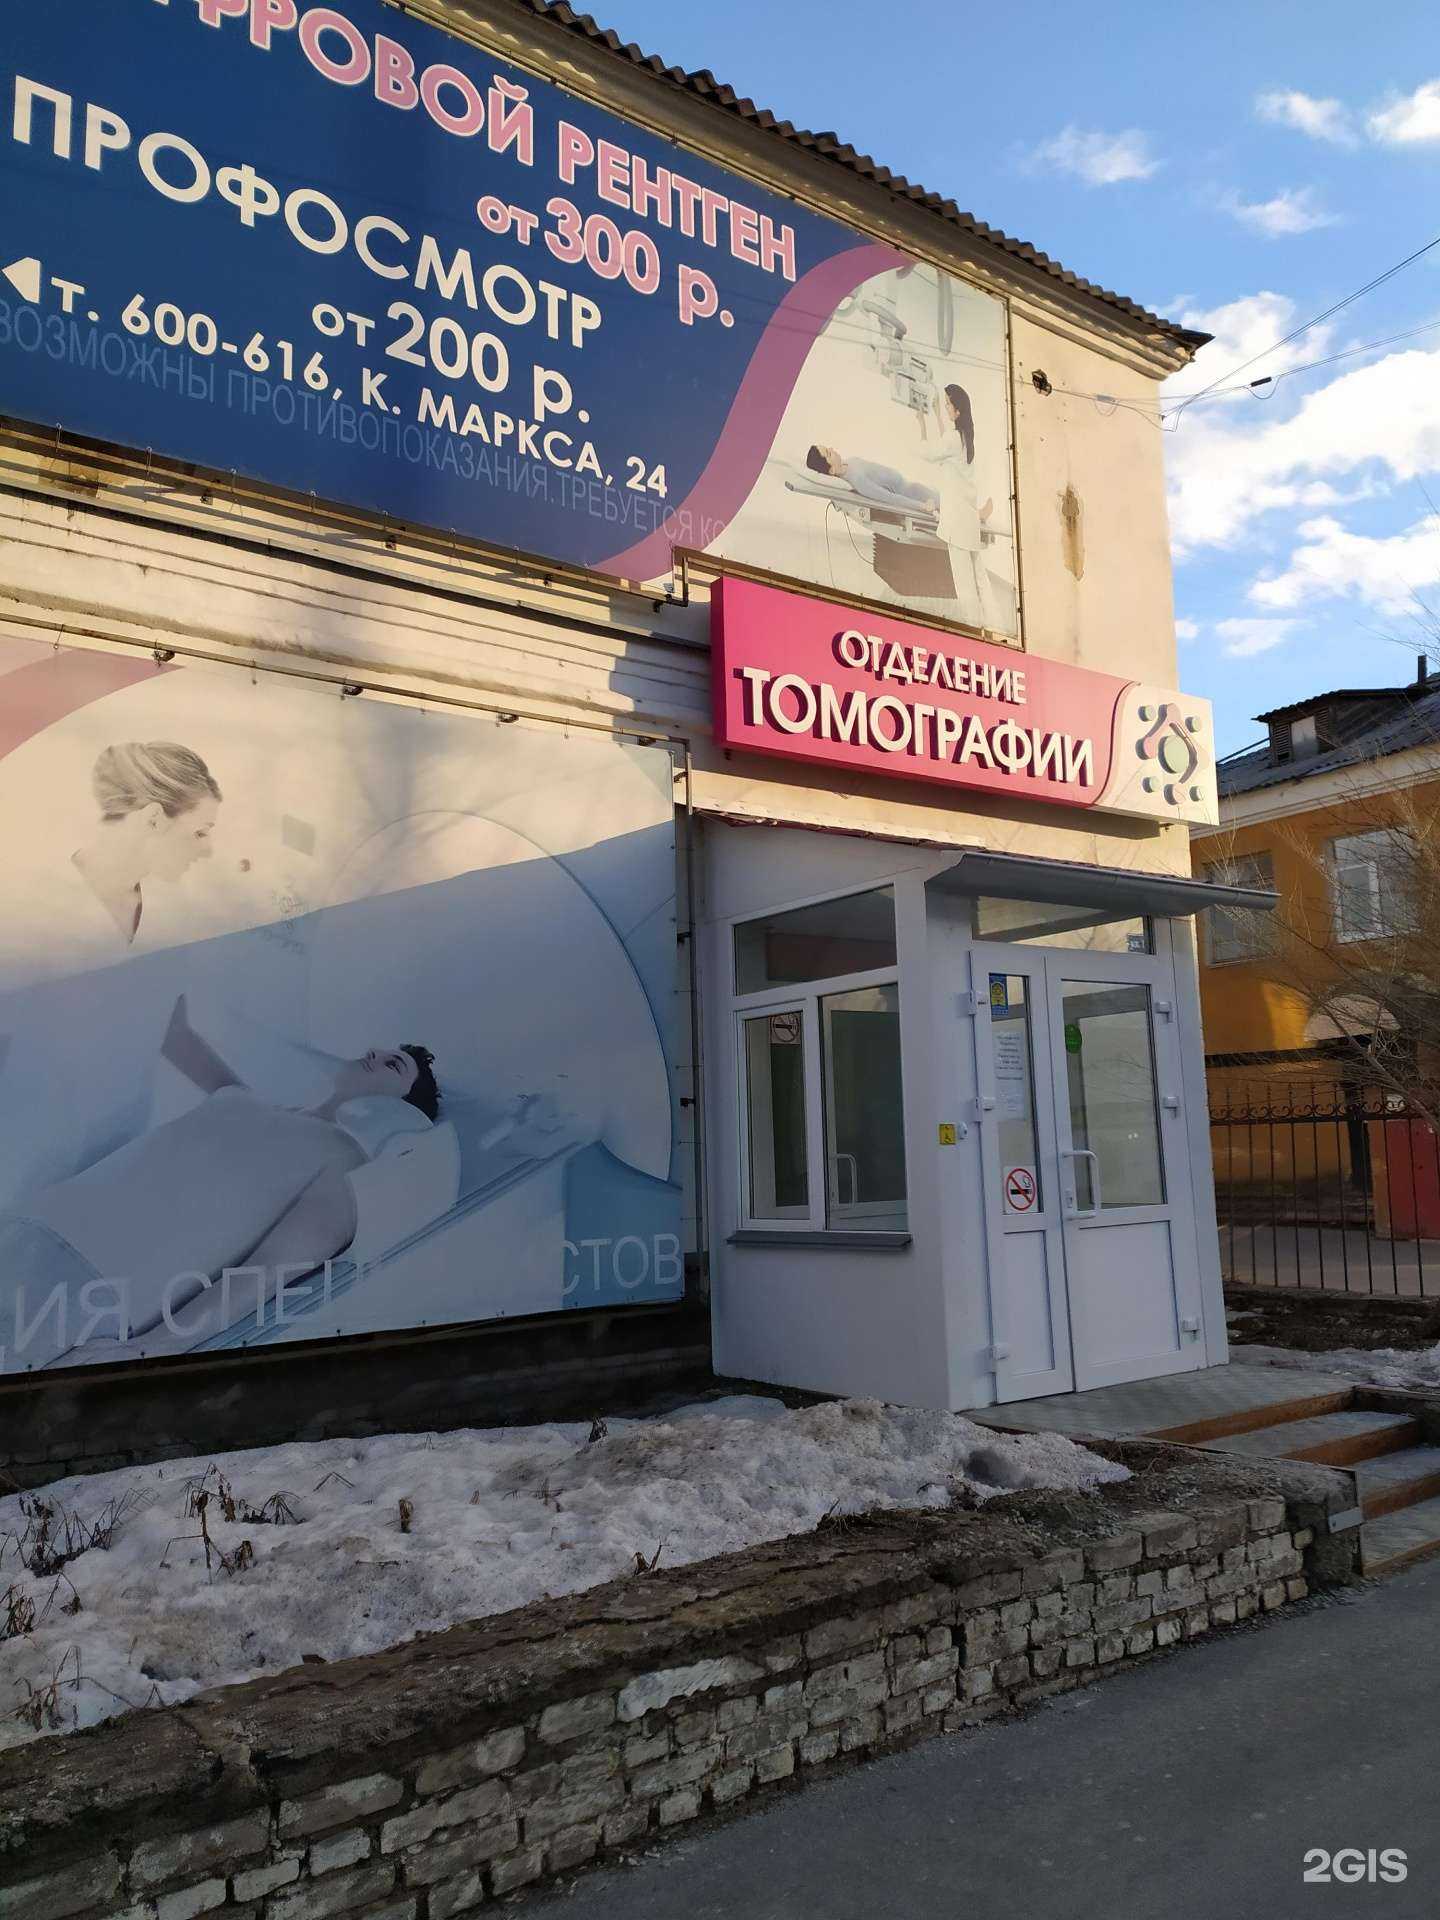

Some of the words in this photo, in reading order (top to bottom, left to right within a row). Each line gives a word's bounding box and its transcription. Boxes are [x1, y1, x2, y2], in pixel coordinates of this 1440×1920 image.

[156, 0, 534, 167] РОВОЙ
[557, 120, 797, 283] РЕНТГЕН
[13, 74, 602, 349] ПРОФОСМОТР
[543, 196, 661, 296] 300
[678, 263, 735, 328] р.
[121, 293, 343, 401] 600-616,
[362, 367, 401, 415] К.
[417, 387, 614, 486] МАРКСА,
[626, 455, 668, 499] 24
[385, 301, 510, 393] 200
[533, 364, 591, 424] р.
[743, 666, 1094, 787] ТОМОГРАФИИ
[836, 630, 1028, 705] ОТДЕЛЕНИЕ
[0, 1277, 131, 1363] ИЯ
